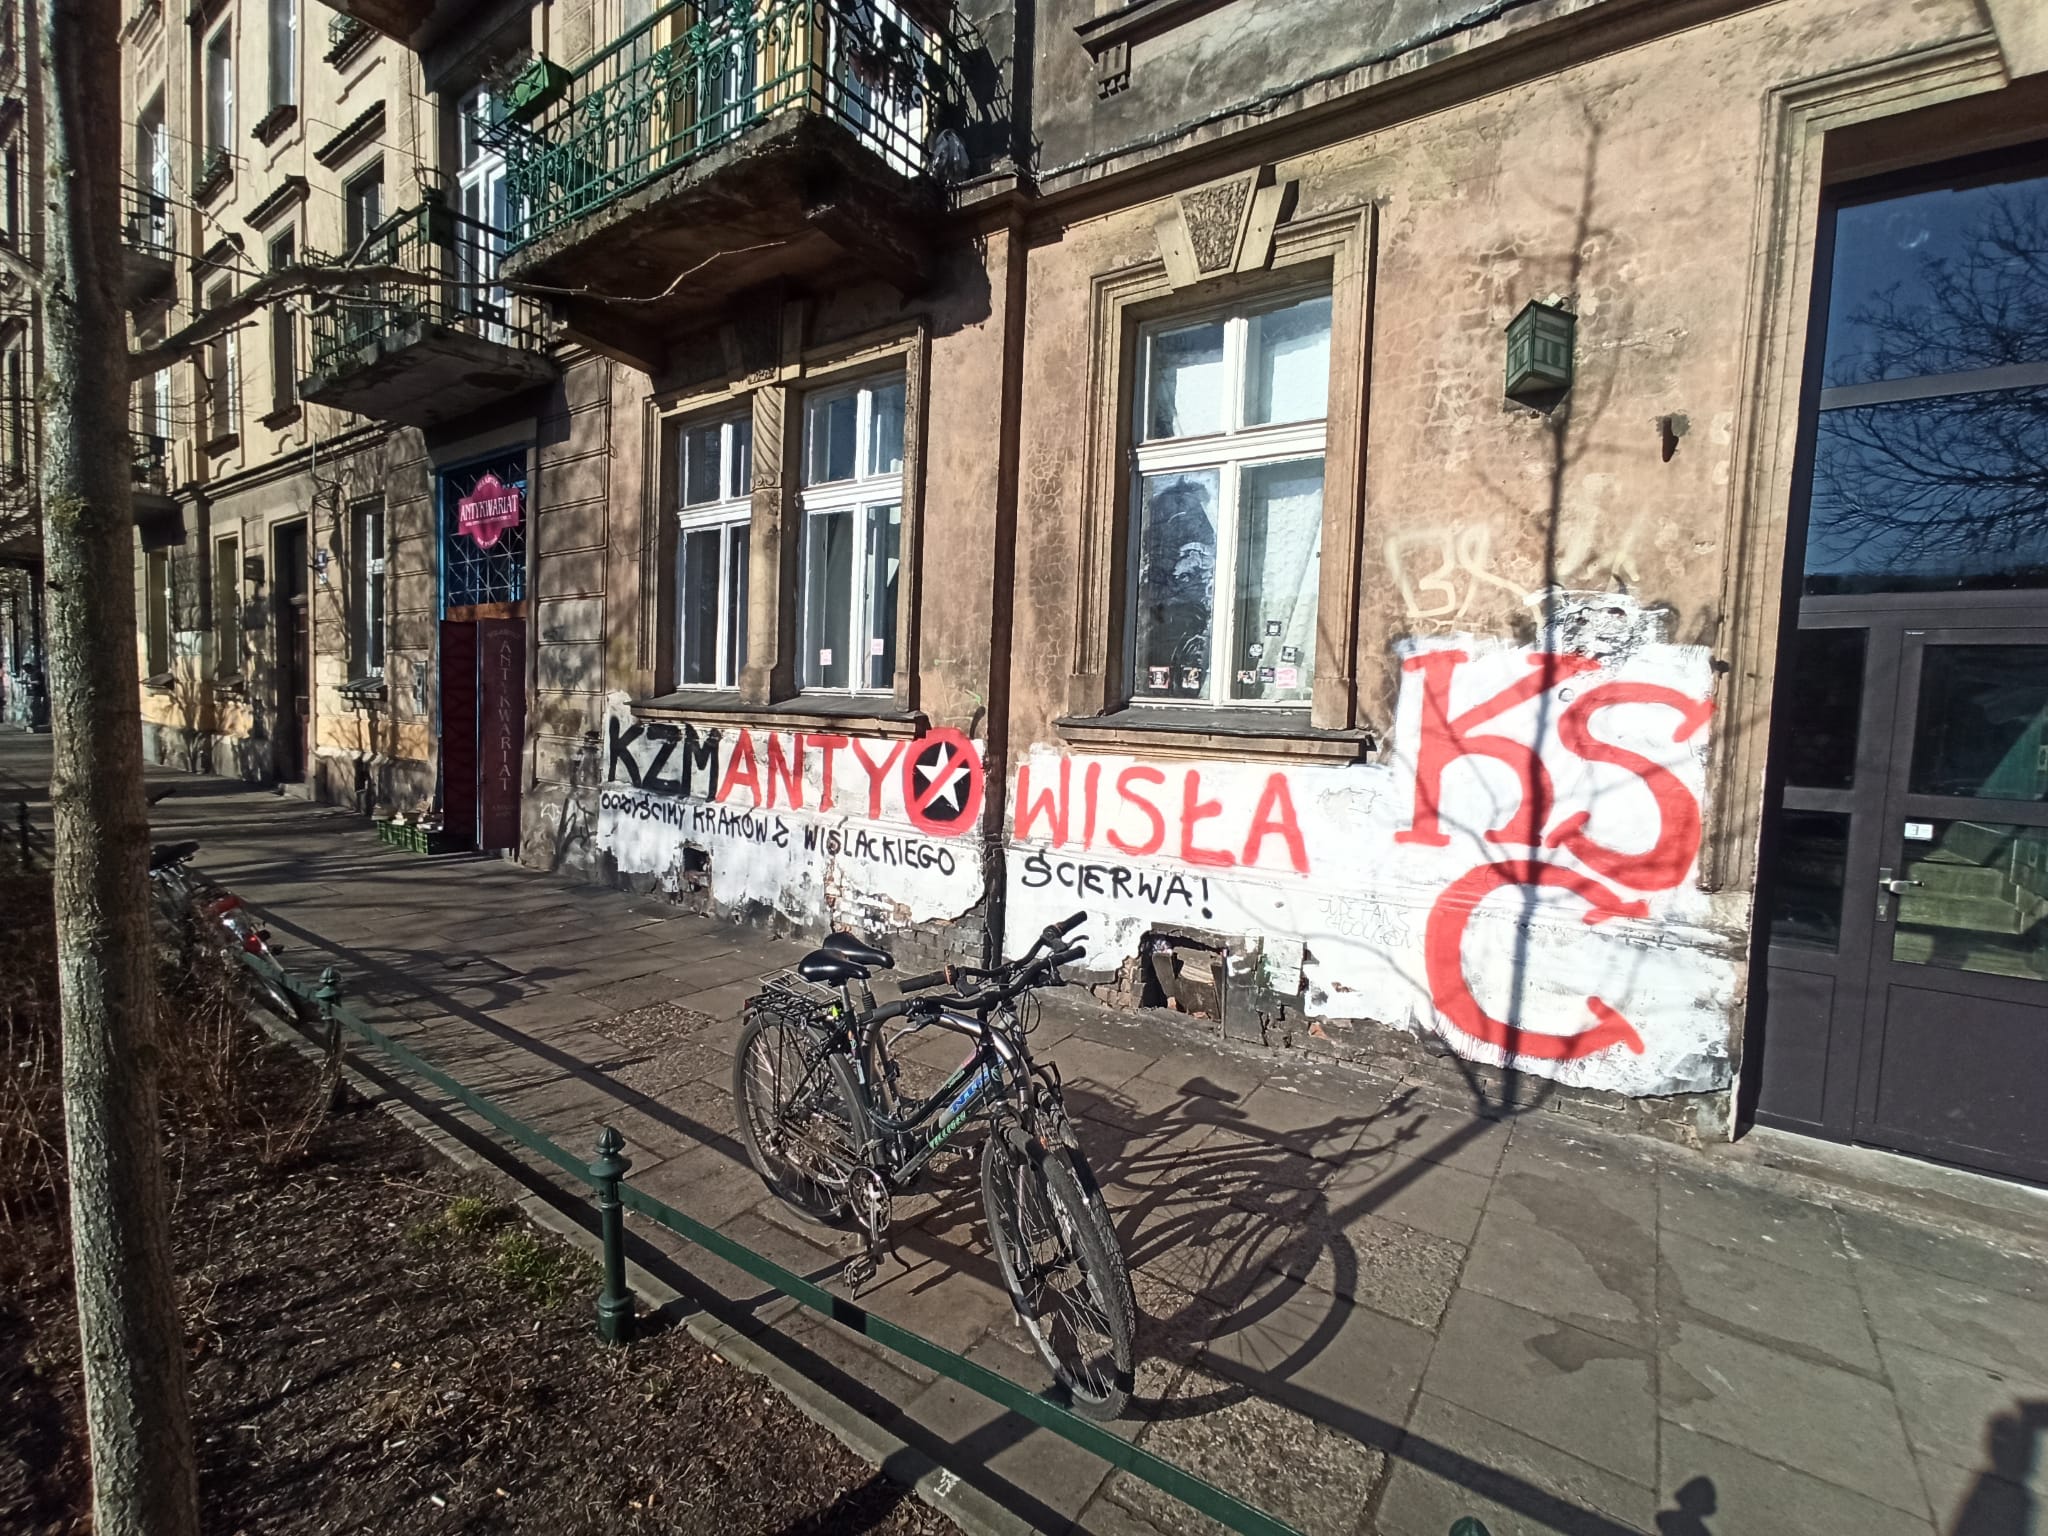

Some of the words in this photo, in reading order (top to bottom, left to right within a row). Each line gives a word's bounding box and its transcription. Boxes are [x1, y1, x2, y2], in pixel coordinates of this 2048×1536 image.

[460, 494, 519, 521] ANTYKWARIAT
[498, 639, 513, 793] ANTYKWARIAT
[1013, 755, 1310, 877] WISŁA
[1395, 649, 1715, 890] KS
[601, 792, 686, 830] OCZYŚCIMY
[693, 806, 768, 843] KRAKÓW
[804, 816, 955, 876] WIŚLACKIEGO
[1021, 849, 1213, 919] ŚCIERWA!
